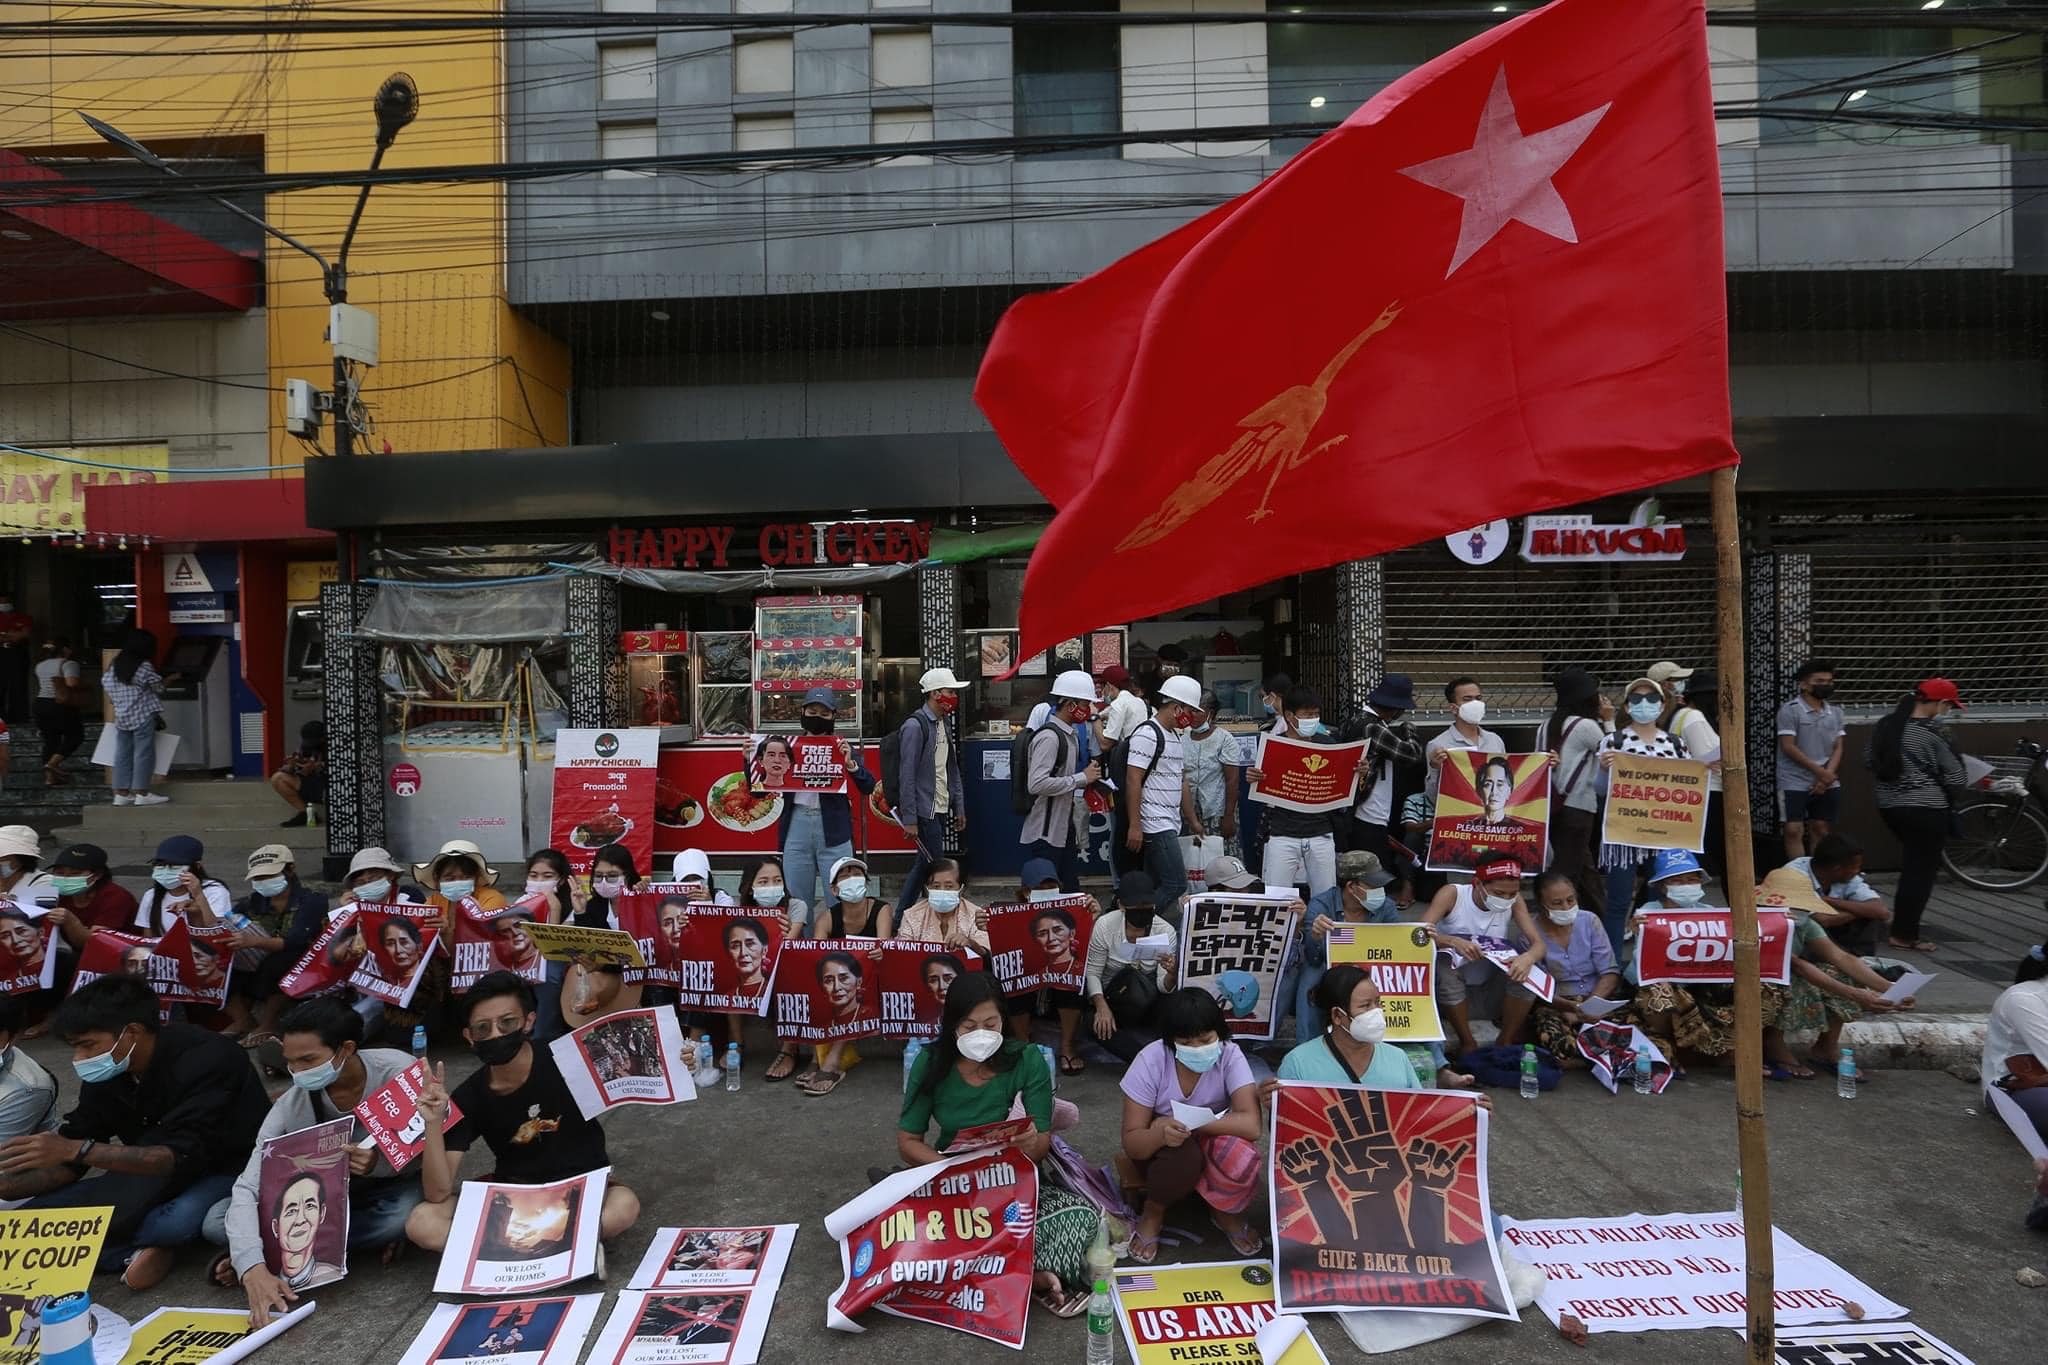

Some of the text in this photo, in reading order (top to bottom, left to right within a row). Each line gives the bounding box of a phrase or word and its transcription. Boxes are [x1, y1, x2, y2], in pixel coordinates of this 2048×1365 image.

[0, 474, 59, 504] AY
[608, 521, 932, 568] HAPPY CHICKEN
[801, 744, 833, 755] FREE
[570, 759, 641, 767] HAPPY CHICKEN
[804, 755, 832, 764] OUR
[793, 764, 843, 774] LEADER
[583, 783, 628, 791] Promotion
[1671, 774, 1699, 785] NEED
[1611, 784, 1703, 806] SEAFOOD
[1617, 807, 1694, 823] FROM CHINA
[1439, 830, 1537, 842] LEADER FUTURE HOPE
[1456, 823, 1485, 833] PLEASE
[1485, 825, 1507, 834] SAVE
[658, 886, 675, 895] OUR
[360, 902, 439, 917] WANT OUR LEADER
[698, 906, 725, 917] WANT
[726, 907, 745, 917] OUR
[746, 908, 782, 918] LEADER
[989, 906, 1005, 916] WE
[1005, 903, 1032, 915] WANT
[1032, 901, 1053, 911] OUR
[529, 925, 630, 940] We Don't Accept
[534, 932, 632, 948] MILITARY COUP
[792, 938, 876, 951] WANT OUR LEADER
[881, 940, 896, 950] WE
[896, 941, 922, 952] WANT
[922, 942, 943, 953] OUR
[279, 973, 298, 990] WE
[293, 952, 316, 979] WANT
[312, 932, 332, 952] OUR
[454, 941, 491, 973] FREE
[1367, 949, 1393, 961] DEAR
[148, 954, 181, 982] FREE
[992, 949, 1024, 982] FREE
[349, 970, 371, 989] DAW
[451, 974, 475, 988] DAW
[623, 967, 669, 983] DAW AUNG
[682, 960, 715, 992] FREE
[1015, 974, 1041, 992] AUNG
[1369, 965, 1428, 994] ARMY
[149, 983, 168, 994] AW
[681, 992, 701, 1005] DAW
[704, 993, 730, 1007] AUNG
[881, 991, 916, 1021] FREE
[1390, 1000, 1413, 1012] SAVE
[776, 992, 810, 1025] FREE
[777, 1024, 799, 1037] DAW
[800, 1024, 826, 1039] AUNG
[862, 1017, 881, 1032] KYI
[882, 1023, 904, 1034] DAW
[906, 1023, 931, 1034] AUNG
[377, 1088, 401, 1118] Free
[356, 1101, 373, 1118] Daw
[366, 1114, 384, 1137] Aung
[378, 1129, 393, 1148] San
[387, 1142, 399, 1156] Su
[939, 1162, 1018, 1197] are with
[23, 1214, 104, 1242] Accept
[880, 1206, 993, 1250] UN & US
[1504, 1223, 1590, 1250] REJECT
[1593, 1222, 1700, 1245] MILITARY
[22, 1245, 91, 1271] COUP
[1318, 1248, 1455, 1276] GIVE BACK OUR
[504, 1263, 543, 1273] WE LOST
[891, 1254, 1007, 1285] every action
[1584, 1256, 1673, 1280] VOTED
[494, 1271, 547, 1283] OUR HOMES
[1290, 1268, 1490, 1306] DEMOCRACY
[1183, 1290, 1225, 1304] DEAR
[1568, 1294, 1692, 1320] RESPECT
[636, 1336, 675, 1345] MYANMAR
[659, 1354, 682, 1362] REAL
[683, 1353, 711, 1361] VOICE
[675, 1347, 697, 1355] LOST
[1170, 1344, 1230, 1361] PLEASE
[484, 1356, 507, 1365] LOST
